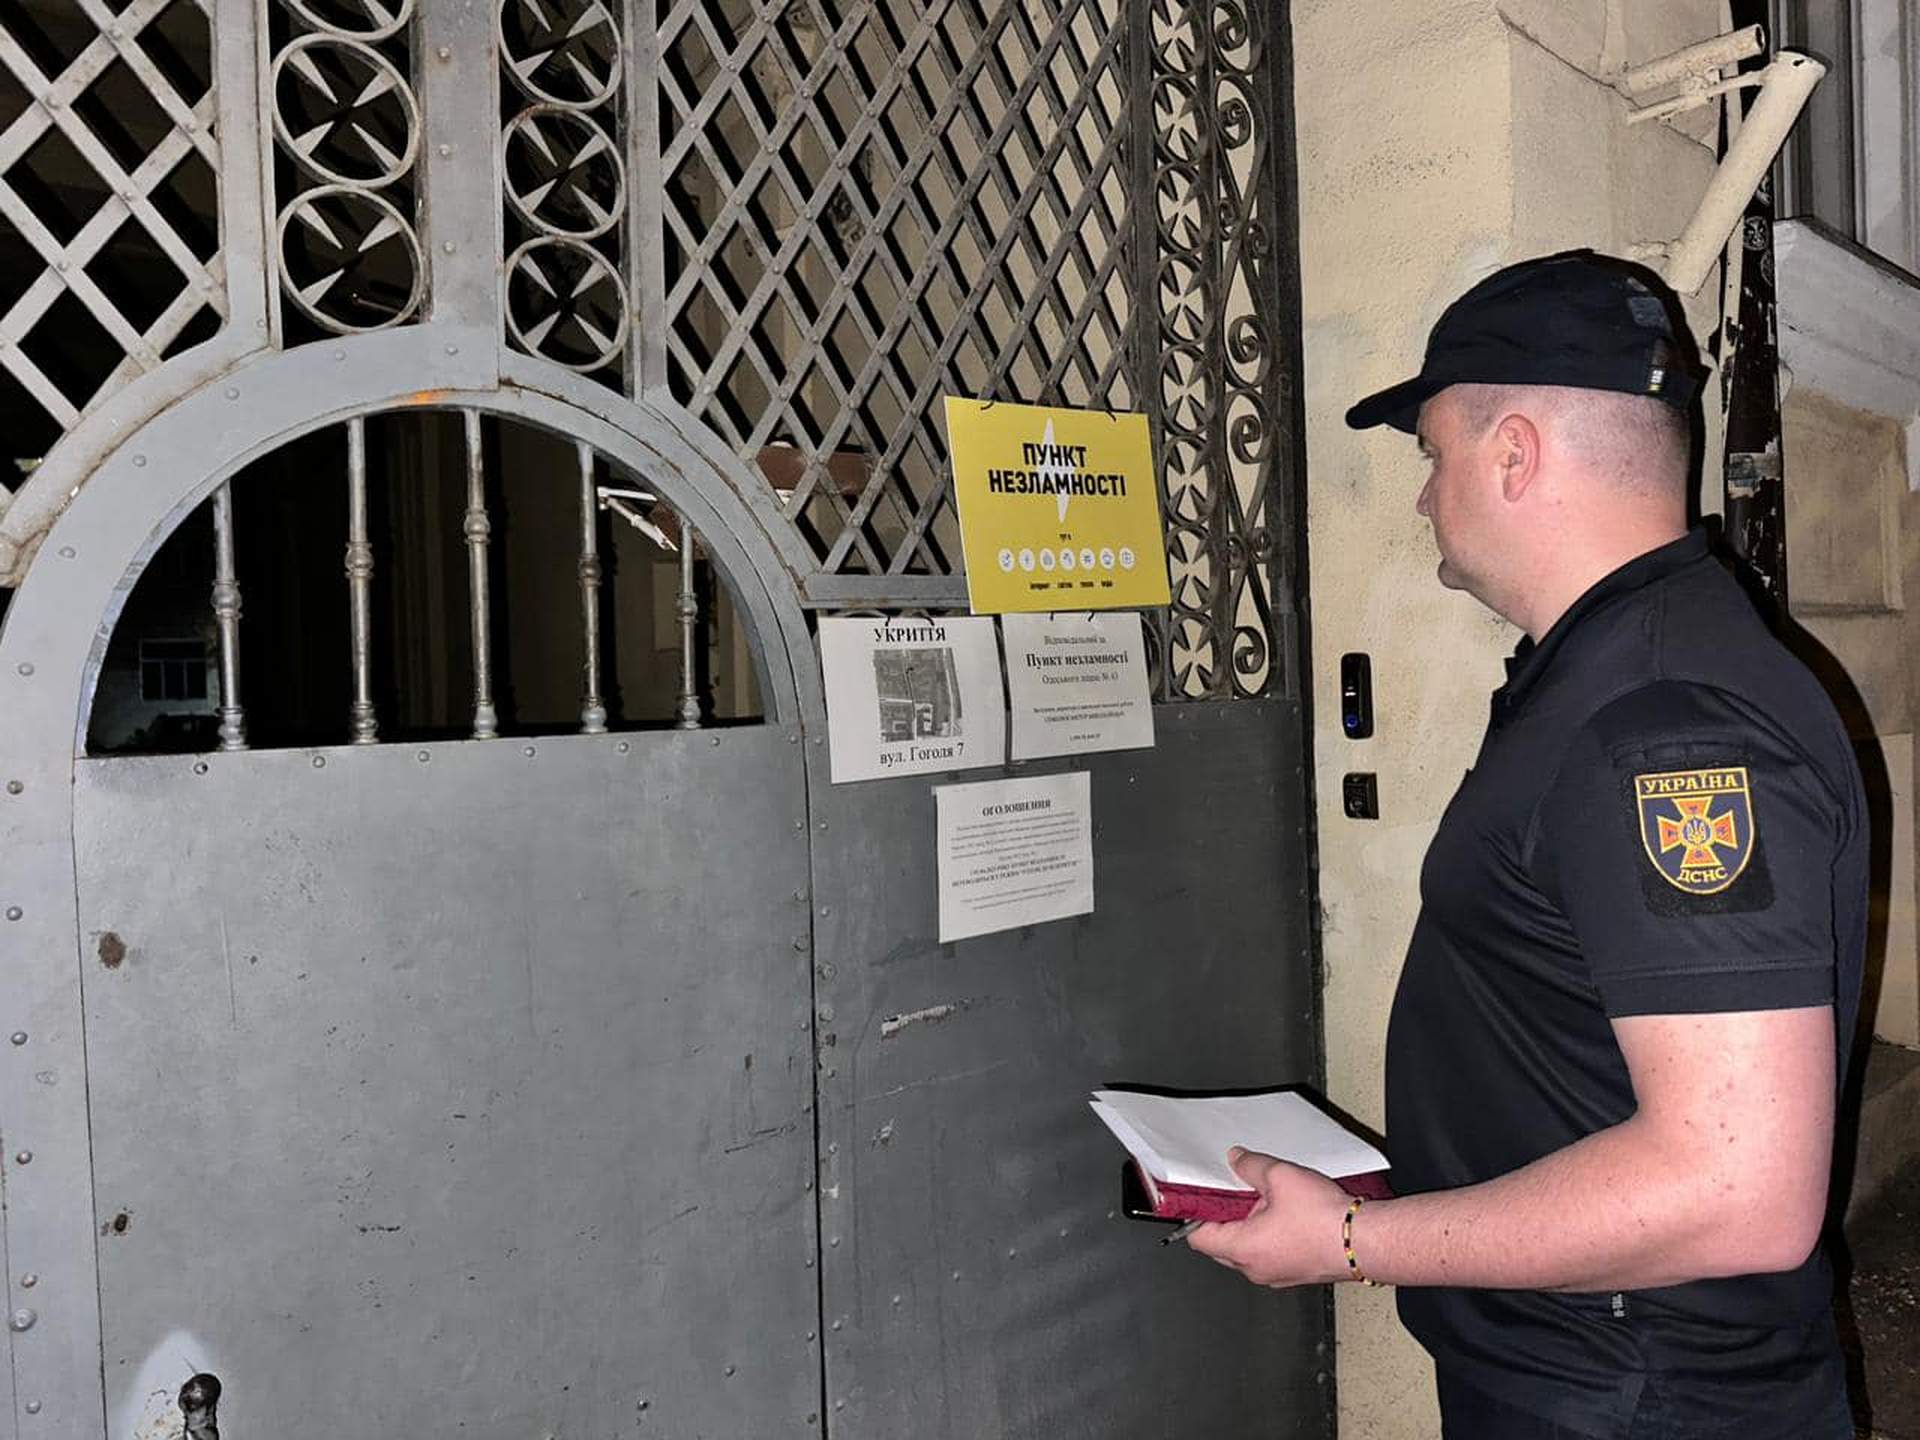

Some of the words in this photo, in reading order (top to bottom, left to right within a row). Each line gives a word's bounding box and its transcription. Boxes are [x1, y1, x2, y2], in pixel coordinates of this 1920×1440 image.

[1022, 443, 1087, 468] ПУНКТ
[988, 469, 1127, 497] НЕЗЛАМНОСТІ
[873, 627, 946, 643] УКРИТТЯ
[1026, 653, 1062, 669] Пункт
[879, 750, 907, 768] вул.
[910, 744, 954, 762] Гоголя
[956, 743, 965, 756] 7
[1644, 773, 1738, 793] УКРАЇНА
[1677, 867, 1729, 884] ДСНС
